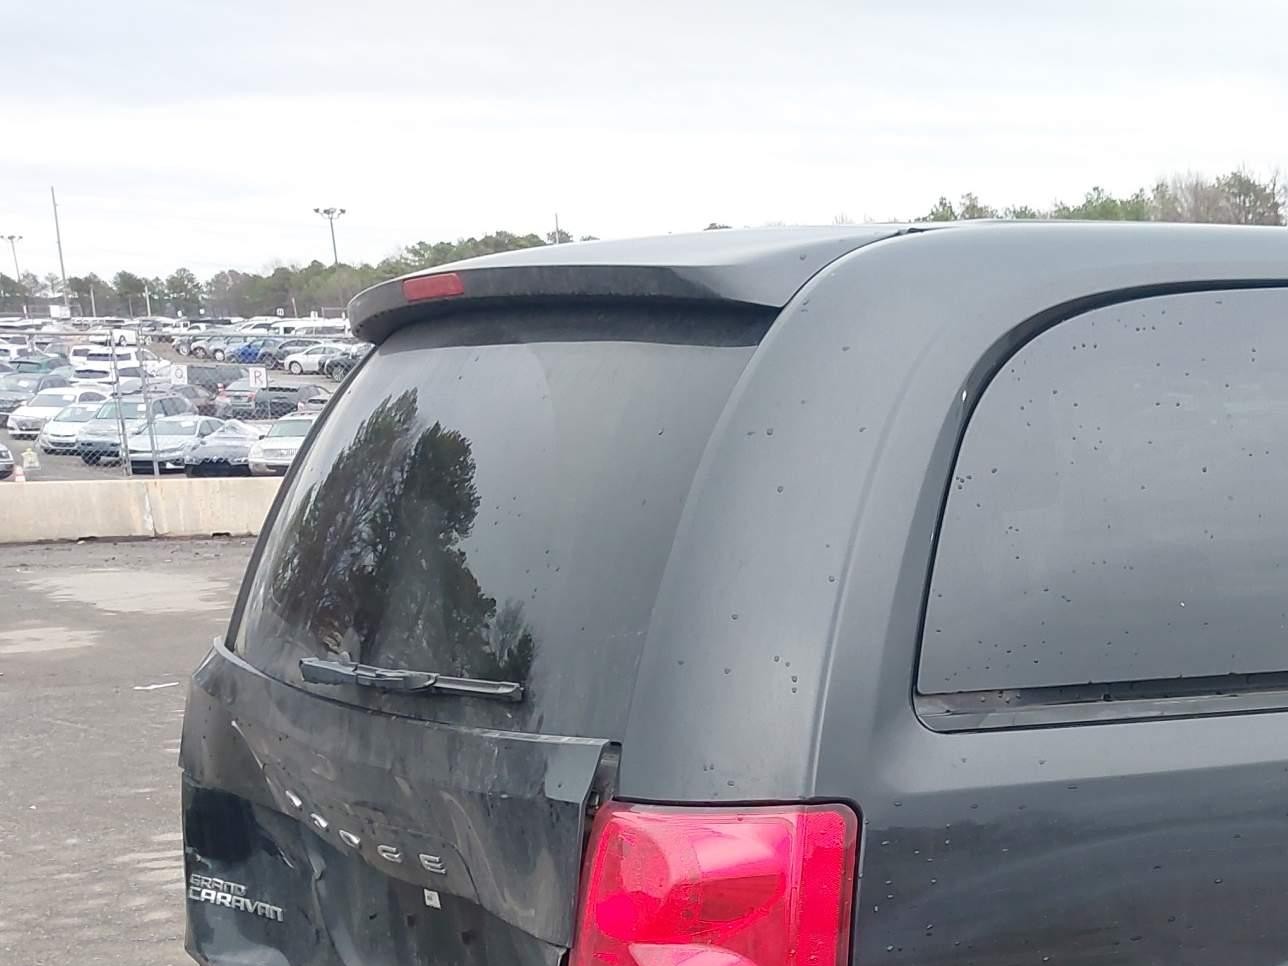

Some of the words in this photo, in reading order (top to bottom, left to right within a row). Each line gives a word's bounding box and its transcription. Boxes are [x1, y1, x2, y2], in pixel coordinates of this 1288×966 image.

[254, 370, 264, 385] R
[190, 874, 247, 896] GRAND
[189, 886, 284, 922] CARAVAN
